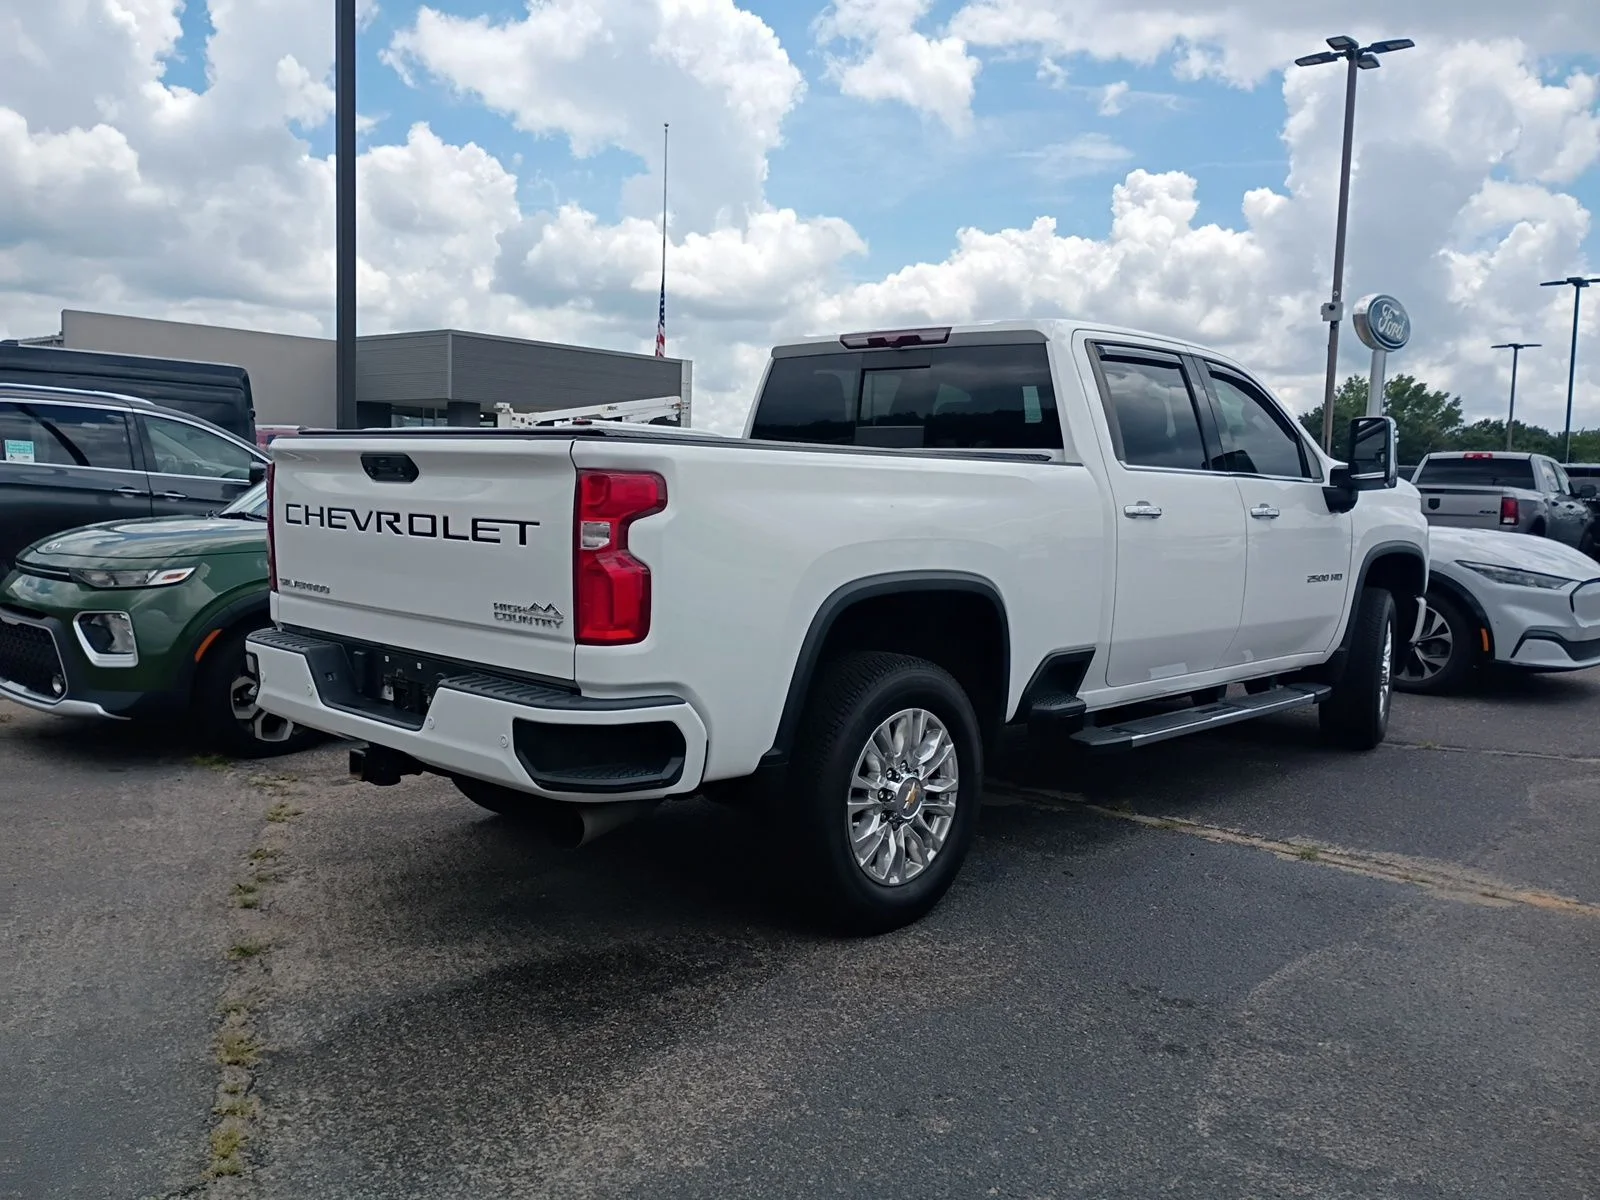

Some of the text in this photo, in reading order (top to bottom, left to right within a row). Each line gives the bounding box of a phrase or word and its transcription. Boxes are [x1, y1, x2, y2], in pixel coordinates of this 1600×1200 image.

[1378, 303, 1405, 340] Ford
[285, 503, 541, 547] CHEVROLET
[1306, 573, 1343, 584] 2500 HD
[493, 602, 528, 614] HIGH
[493, 611, 564, 630] COUNTRY
